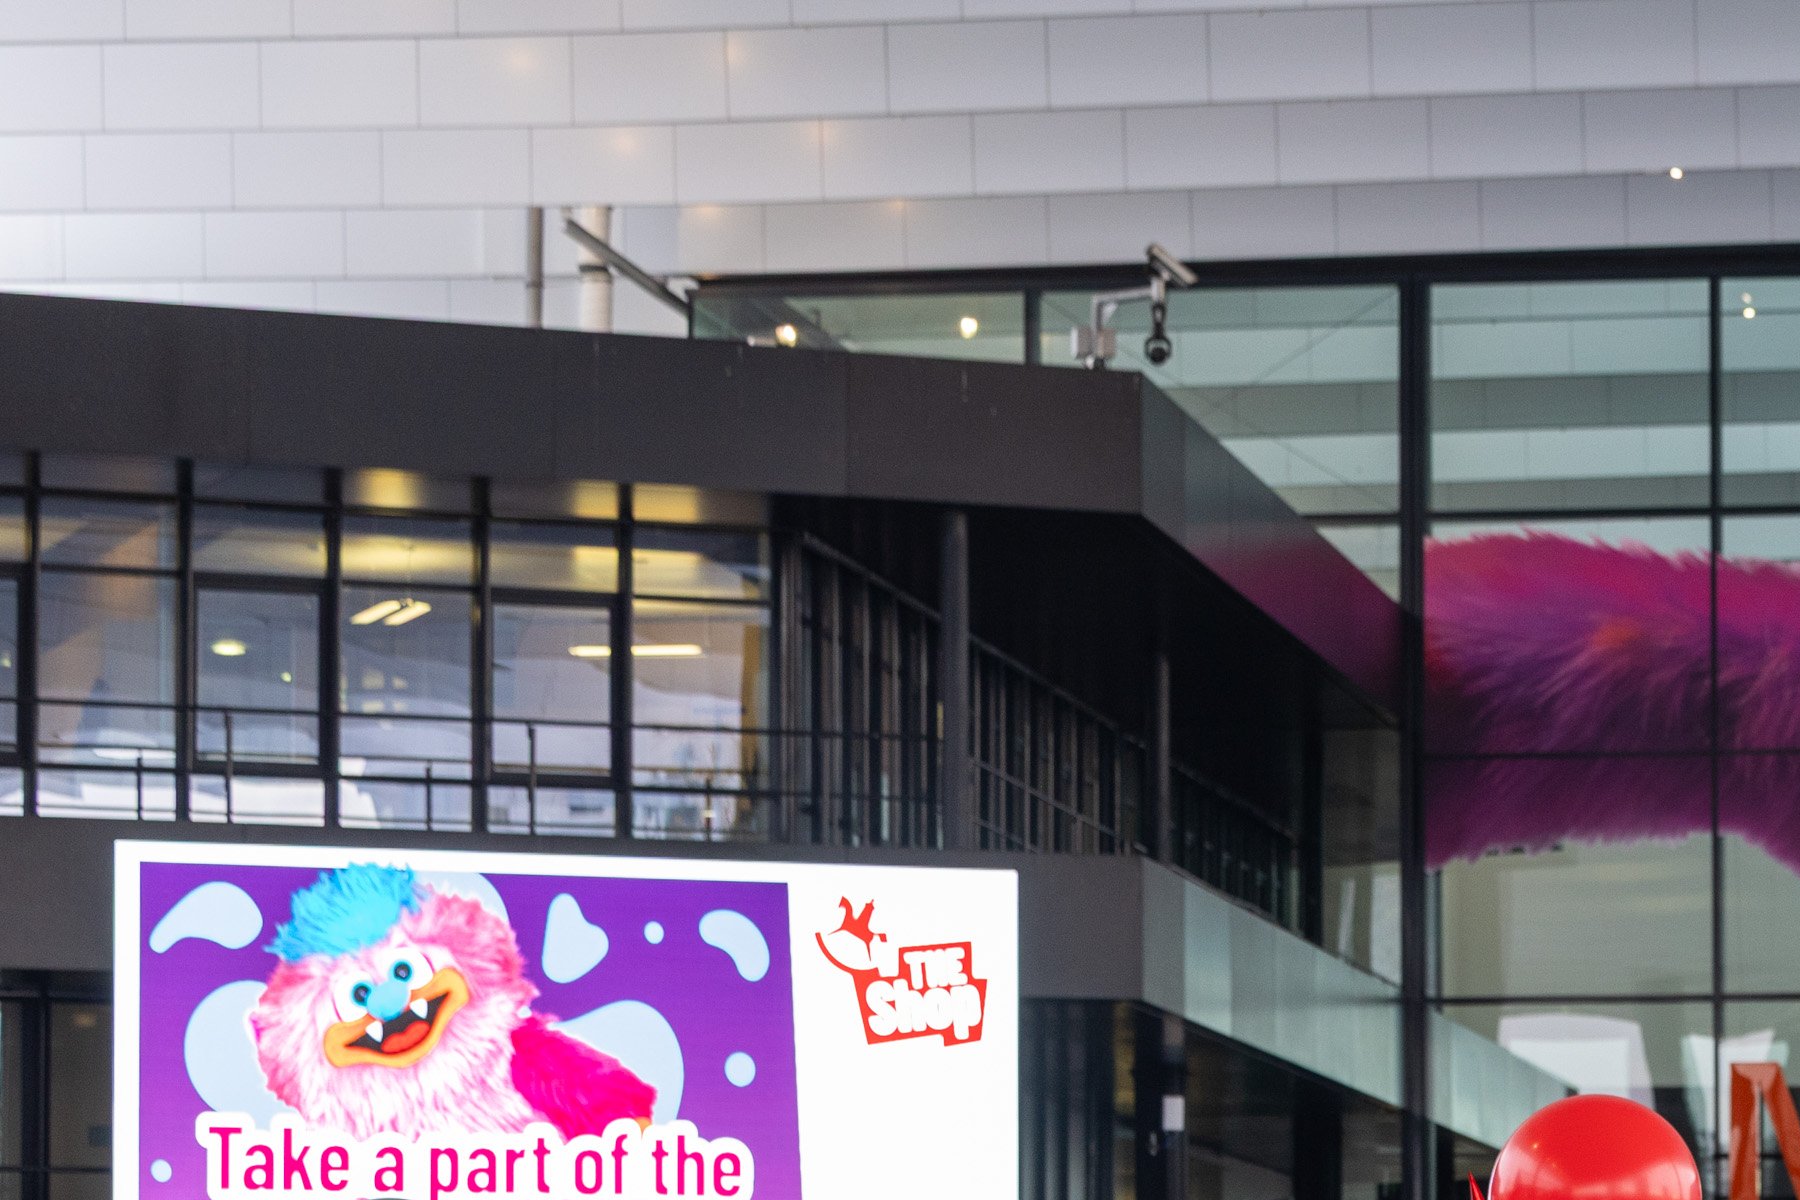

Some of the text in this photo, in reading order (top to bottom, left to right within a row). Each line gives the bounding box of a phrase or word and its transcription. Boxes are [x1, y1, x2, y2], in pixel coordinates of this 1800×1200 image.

[903, 946, 968, 990] THE
[209, 1126, 350, 1191] Take
[374, 1146, 404, 1191] a
[574, 1135, 629, 1196] of
[652, 1135, 742, 1197] the
